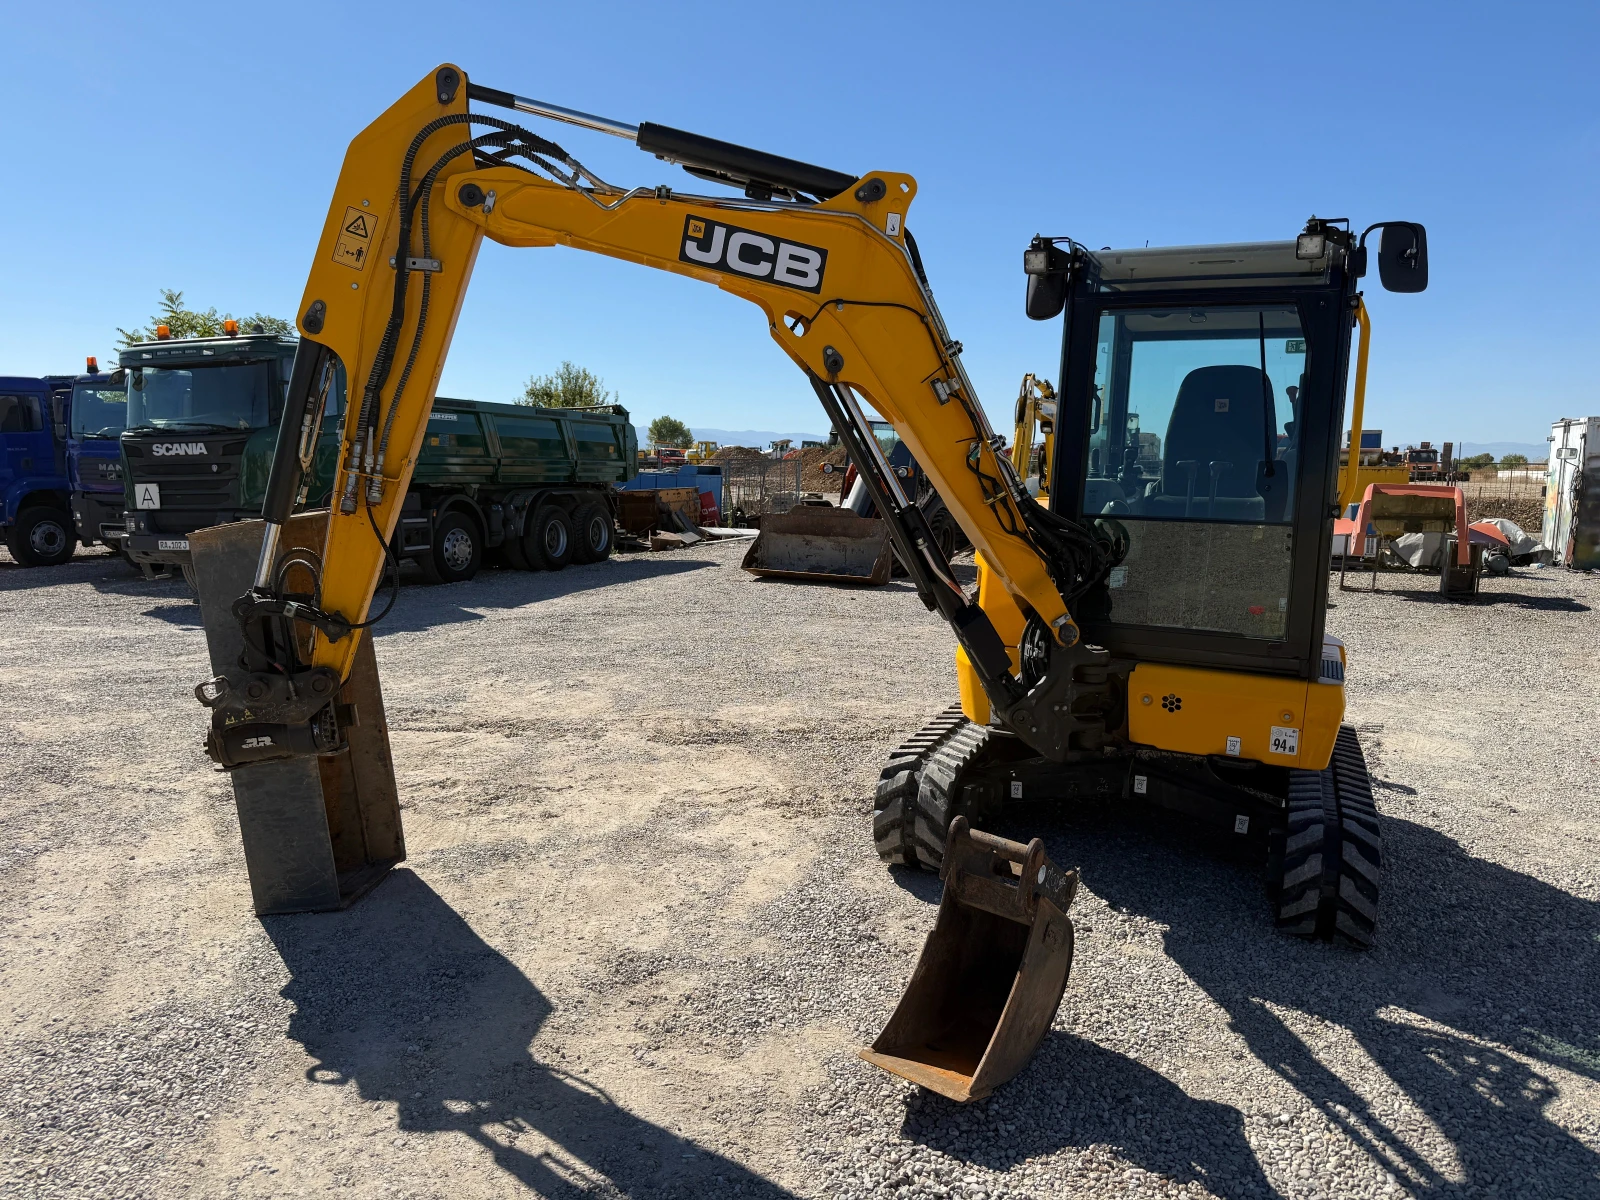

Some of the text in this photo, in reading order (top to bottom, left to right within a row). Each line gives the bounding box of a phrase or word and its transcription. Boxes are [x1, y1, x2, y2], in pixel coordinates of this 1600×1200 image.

[685, 225, 822, 288] JCB
[152, 442, 208, 456] SCANIA
[98, 463, 122, 471] MAN
[142, 485, 155, 506] A
[1273, 738, 1287, 752] 94
